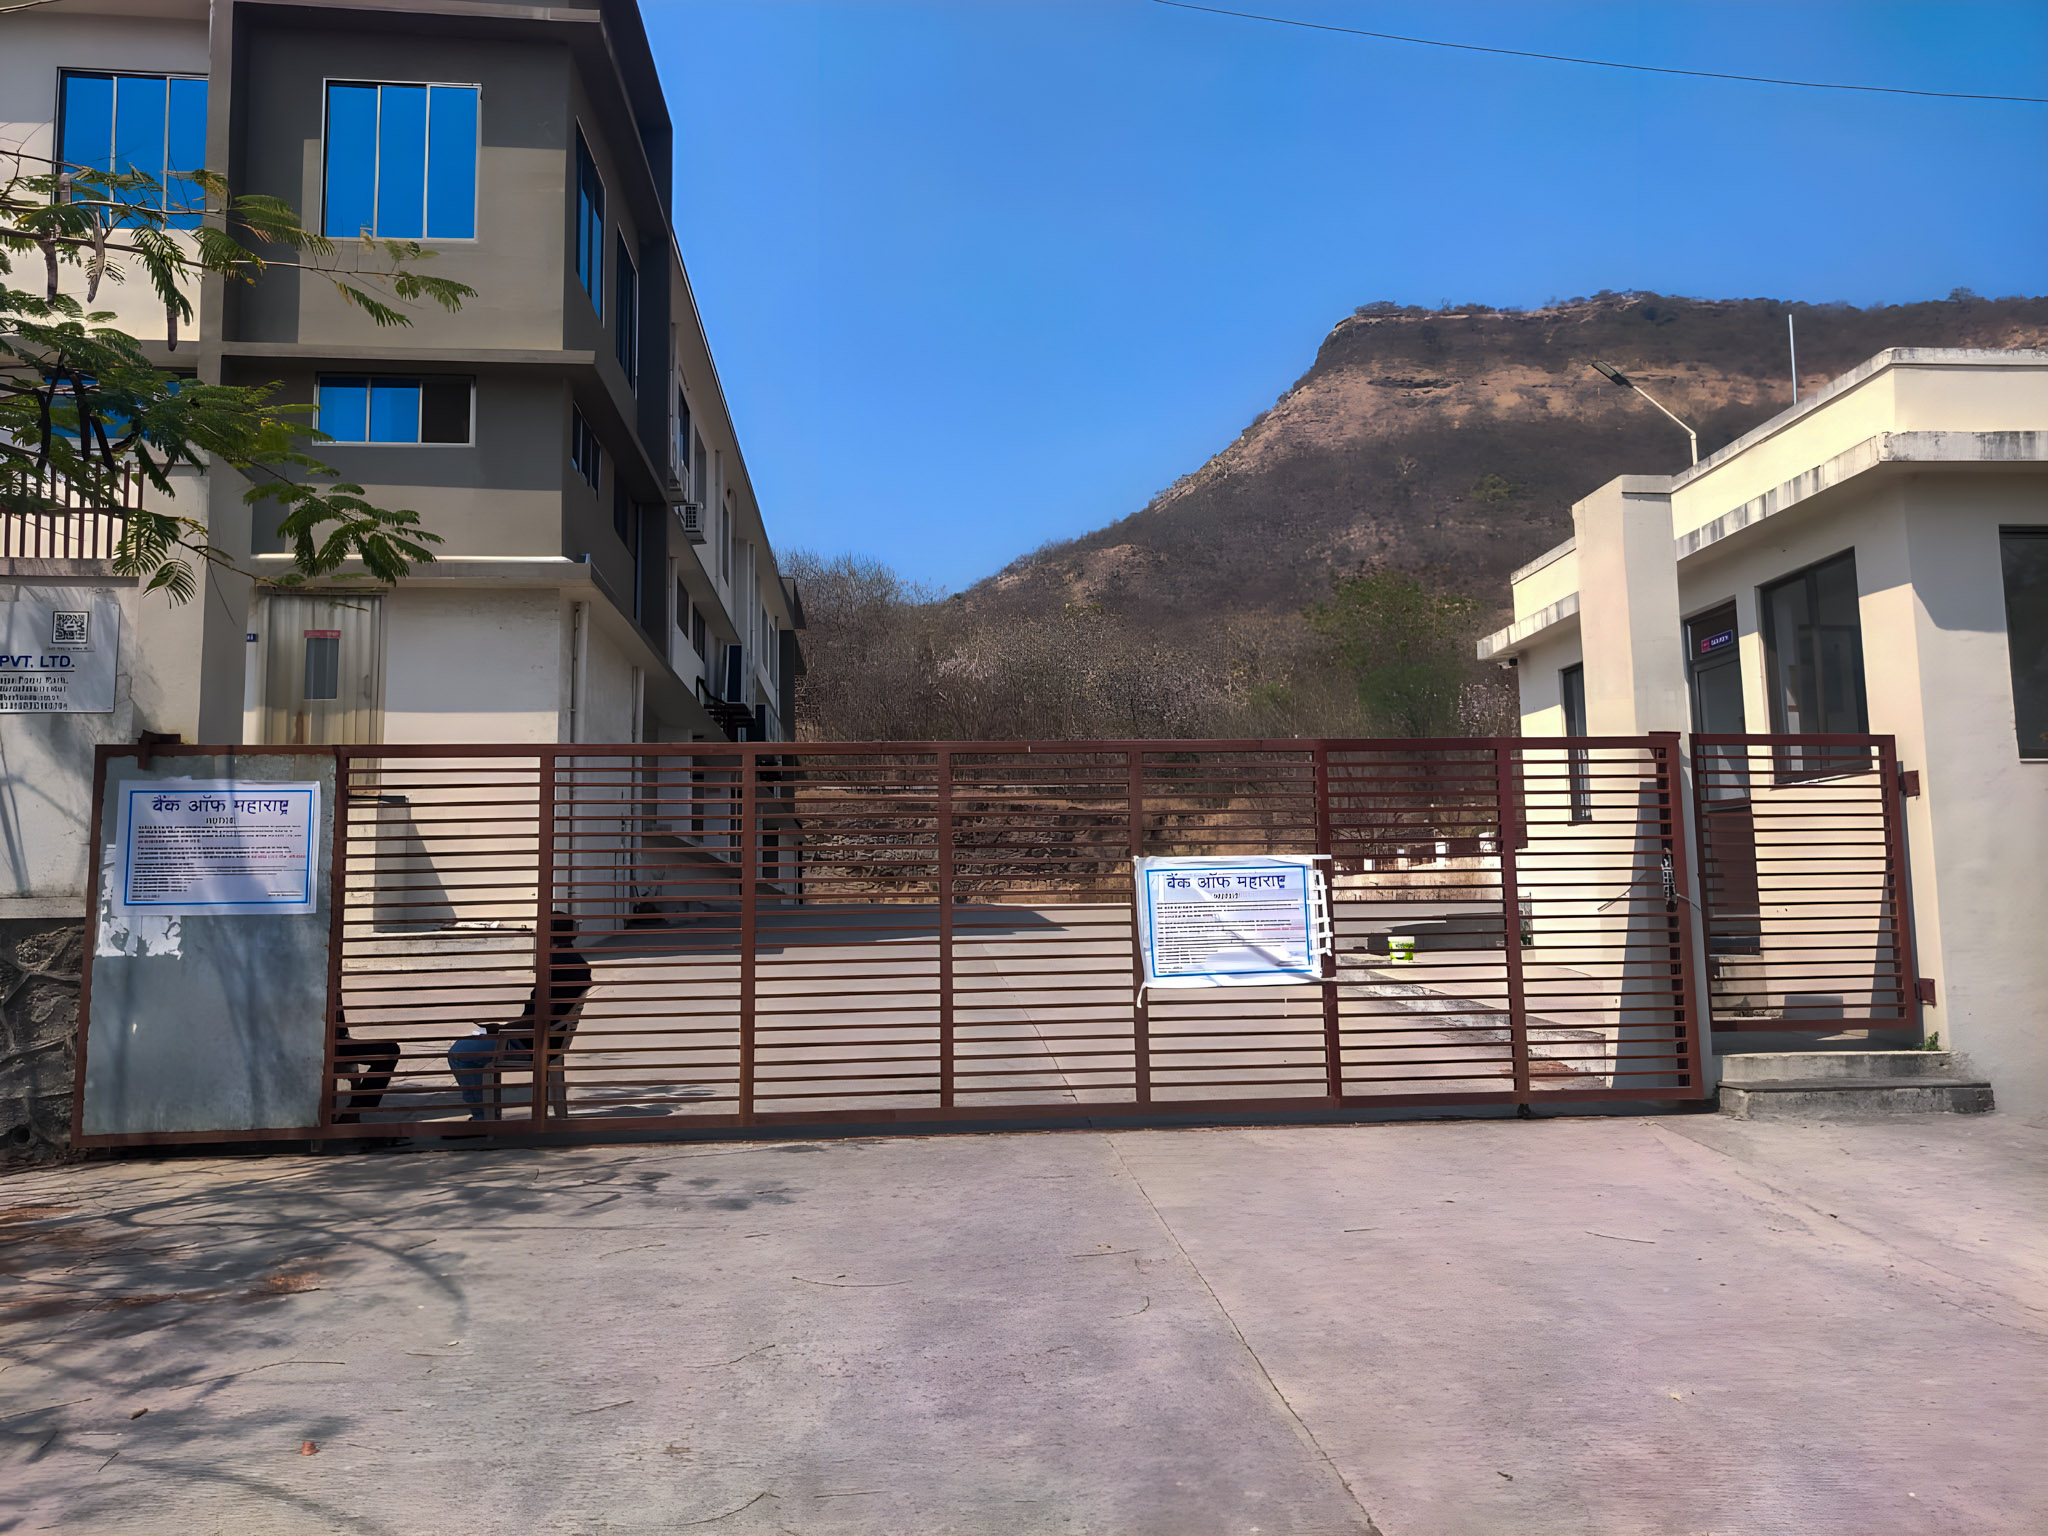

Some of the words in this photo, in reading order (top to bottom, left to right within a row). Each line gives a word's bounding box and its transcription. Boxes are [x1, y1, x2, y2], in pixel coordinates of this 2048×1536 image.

[0, 655, 33, 668] PVT.
[40, 655, 75, 668] LTD.
[152, 795, 181, 812] बैंक
[188, 795, 226, 812] ऑफ
[1166, 873, 1191, 889] बैंक
[1197, 872, 1231, 889] ऑफ
